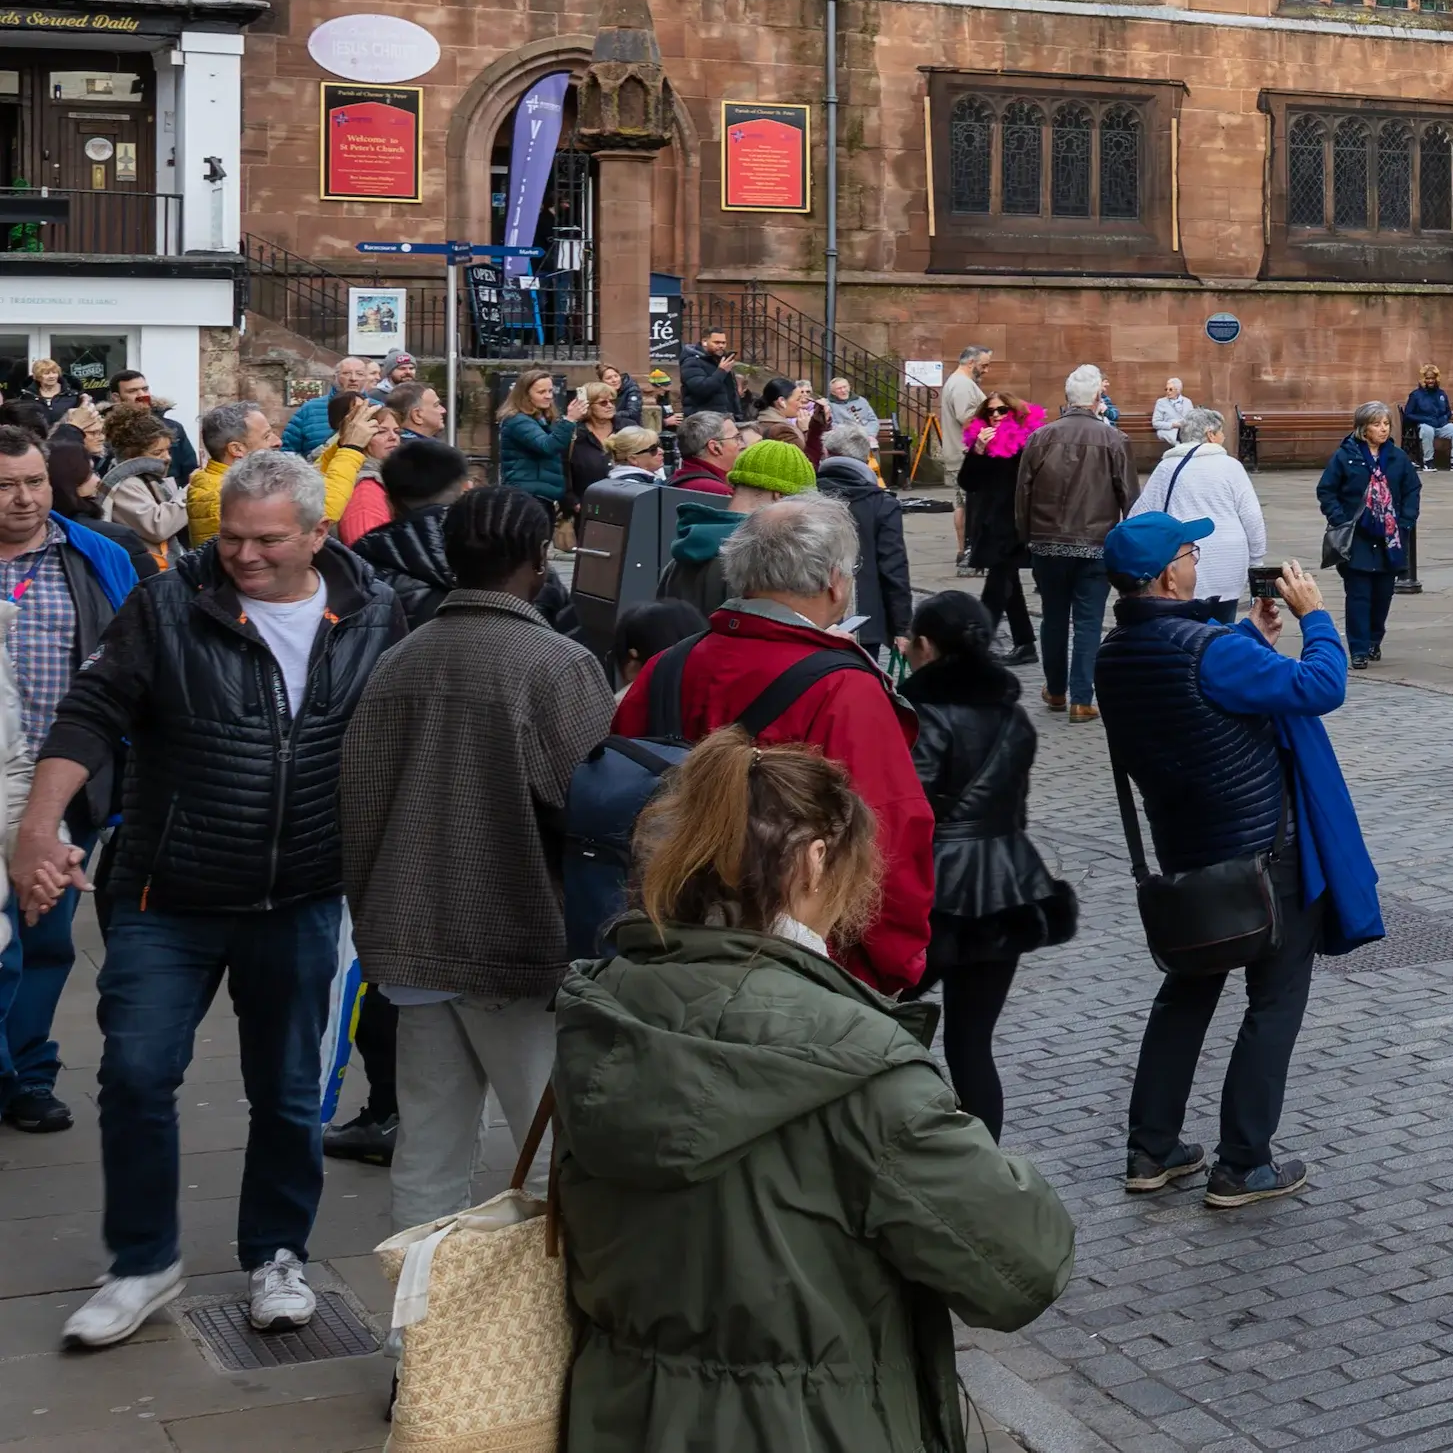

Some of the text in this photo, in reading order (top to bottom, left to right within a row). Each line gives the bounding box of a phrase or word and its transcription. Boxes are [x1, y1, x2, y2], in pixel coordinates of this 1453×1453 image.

[26, 11, 90, 28] Served
[92, 14, 140, 32] Daily
[347, 135, 386, 144] Welcome
[350, 144, 375, 152] Peter's
[376, 145, 405, 153] Church
[473, 267, 497, 282] OPEN
[10, 296, 73, 305] TRADIZIONALE
